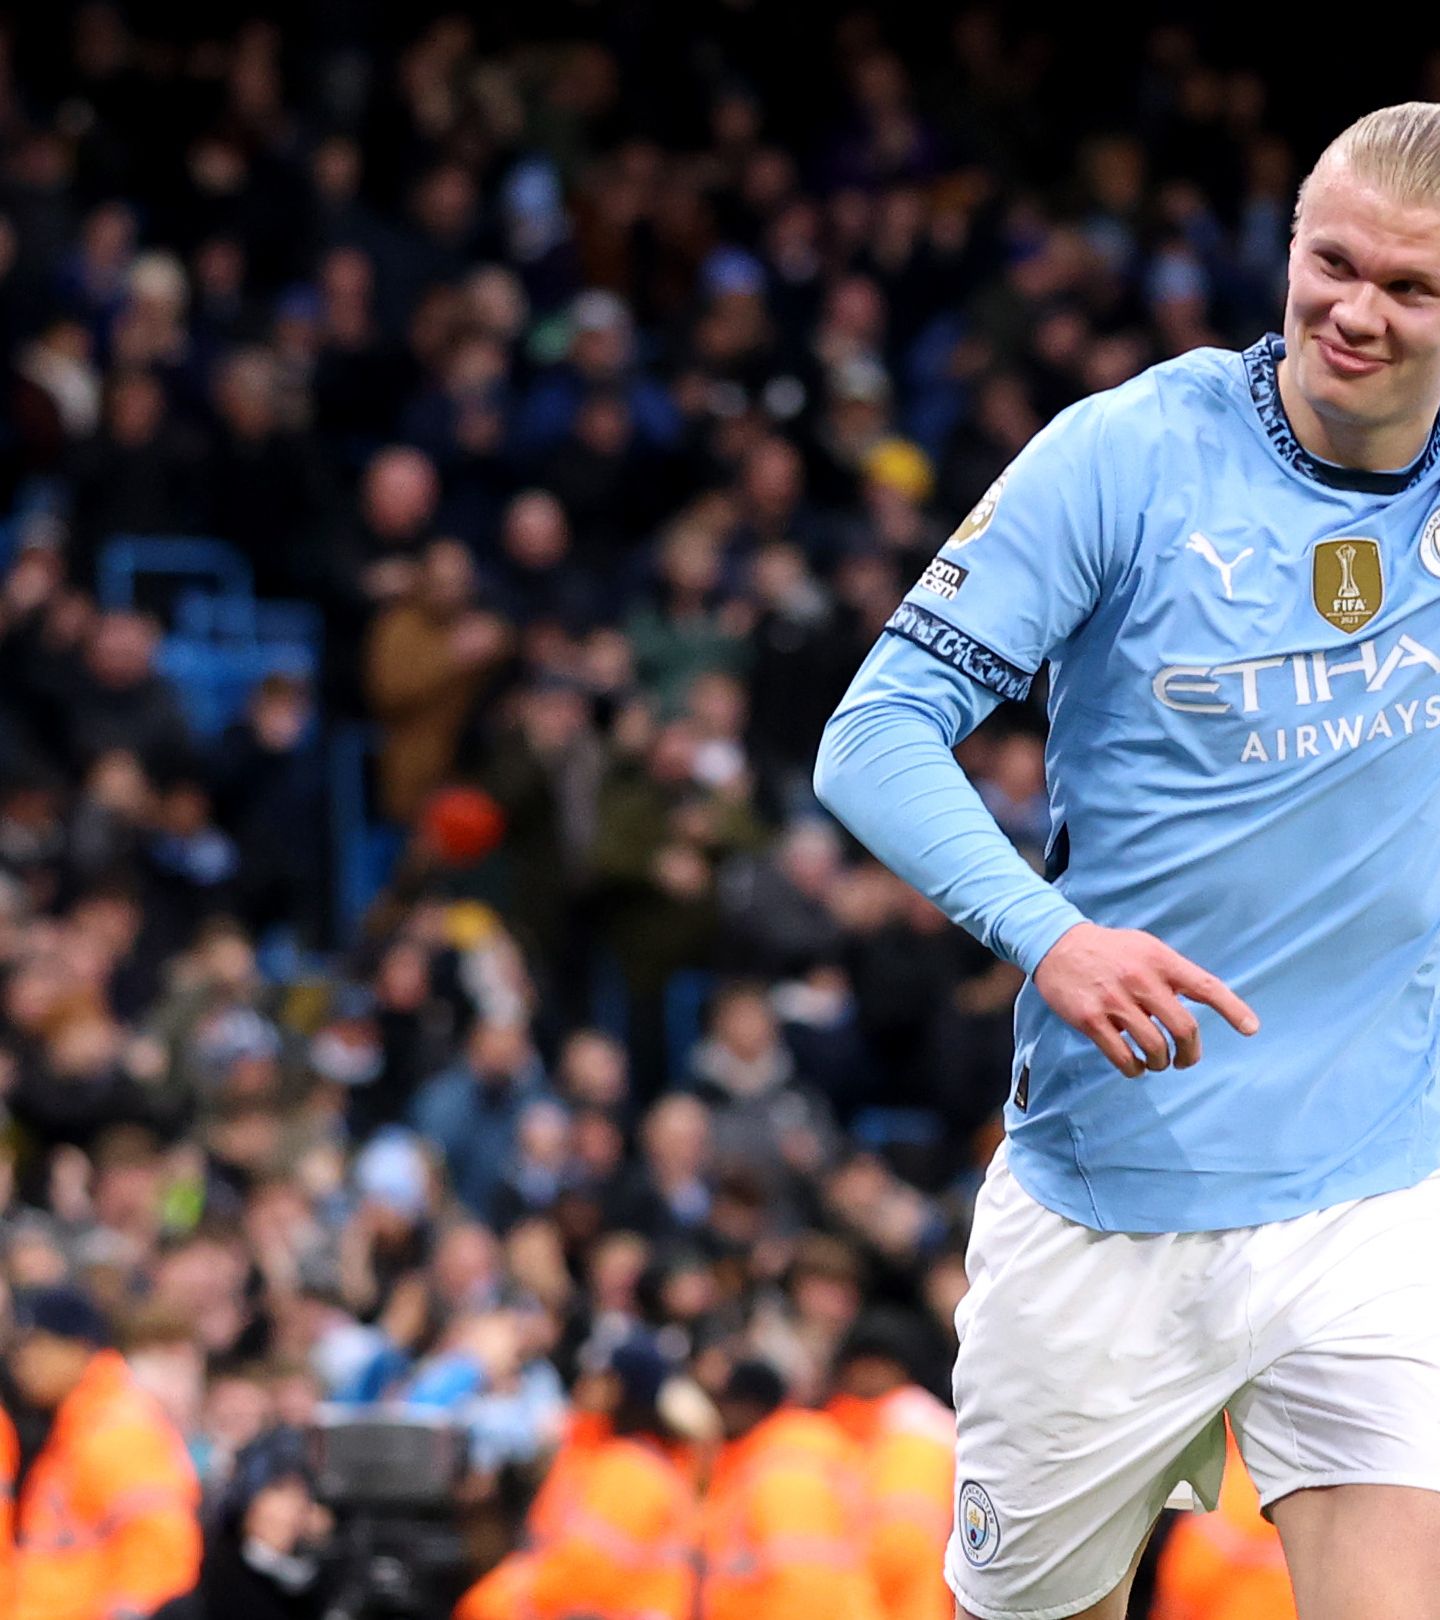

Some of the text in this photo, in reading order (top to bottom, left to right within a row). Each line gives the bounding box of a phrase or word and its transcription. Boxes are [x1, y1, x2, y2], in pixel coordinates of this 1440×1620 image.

[925, 558, 960, 584] om
[1333, 598, 1365, 612] FIFA
[963, 1486, 994, 1525] MANCHESTER
